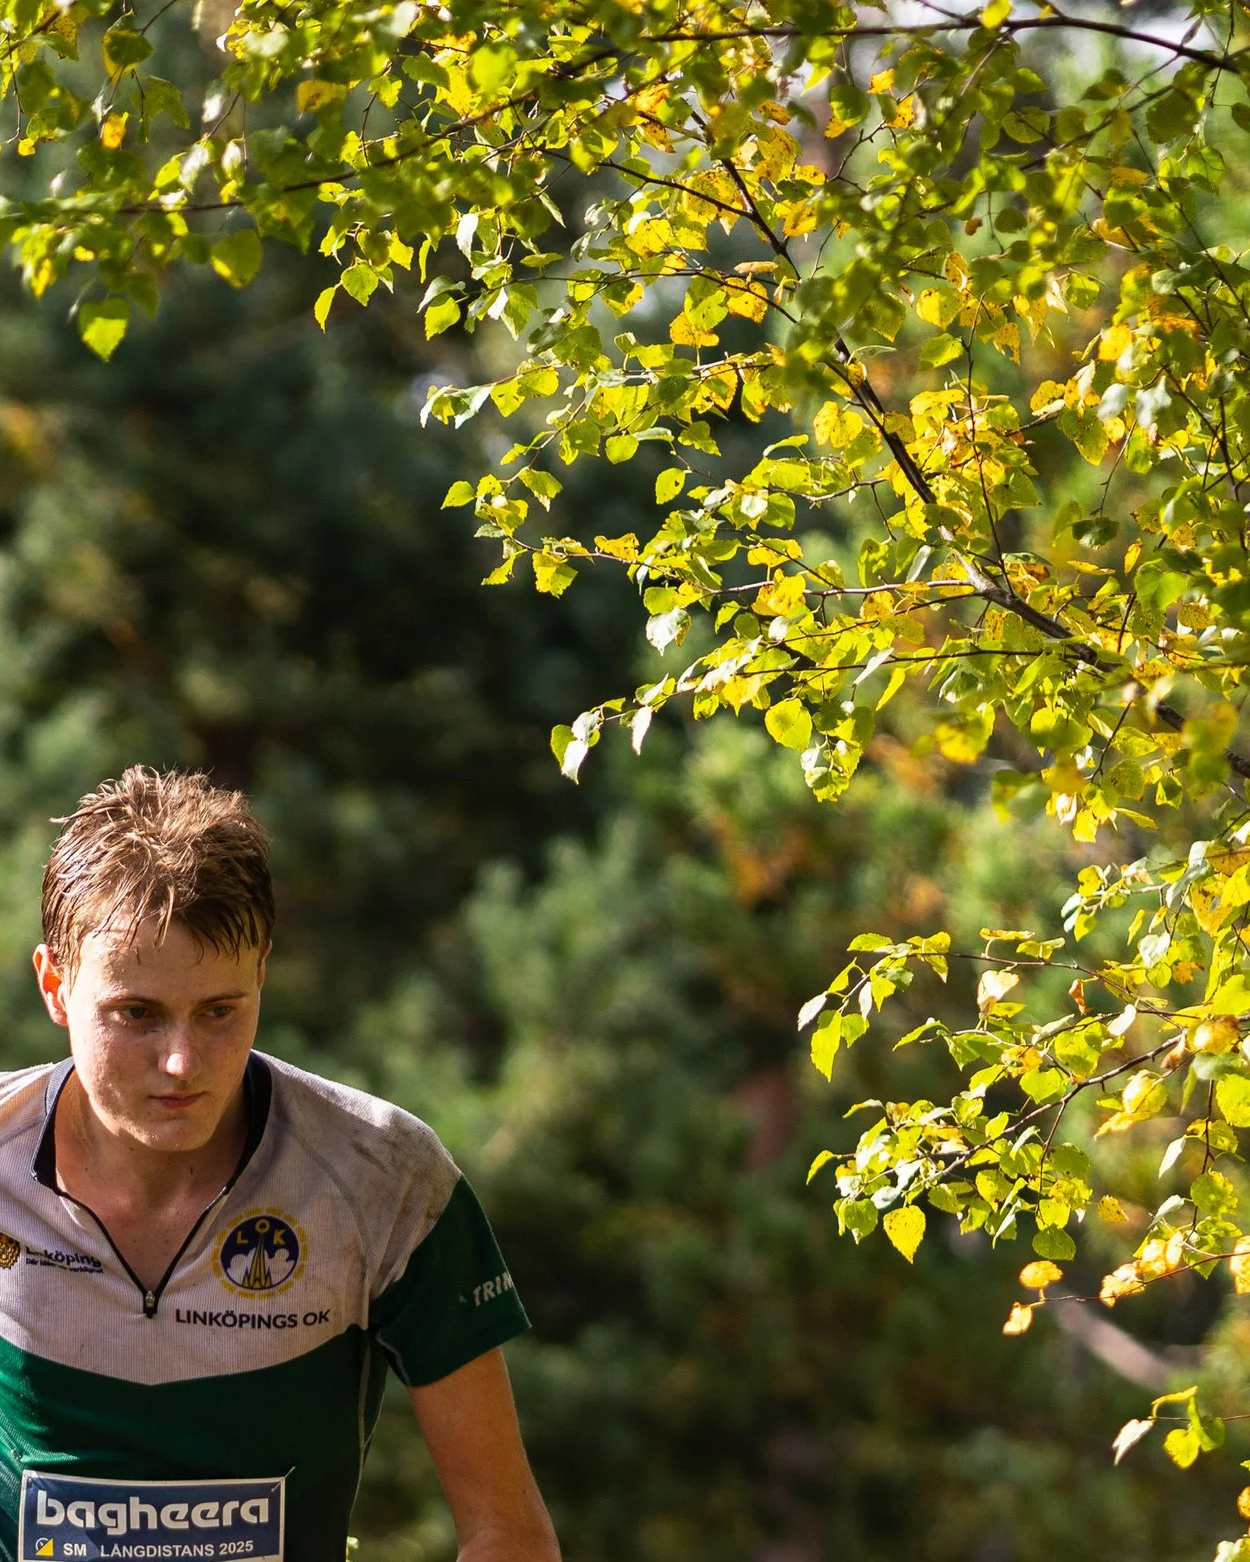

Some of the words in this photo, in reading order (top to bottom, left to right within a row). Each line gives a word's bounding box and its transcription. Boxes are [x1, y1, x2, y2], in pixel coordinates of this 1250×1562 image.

[175, 1308, 298, 1329] LINKÖPINGS
[303, 1308, 331, 1326] OK
[36, 1490, 269, 1535] bagheera
[63, 1542, 87, 1556] SM
[100, 1543, 214, 1558] LÅNGDISTANS
[219, 1540, 254, 1556] 2025
